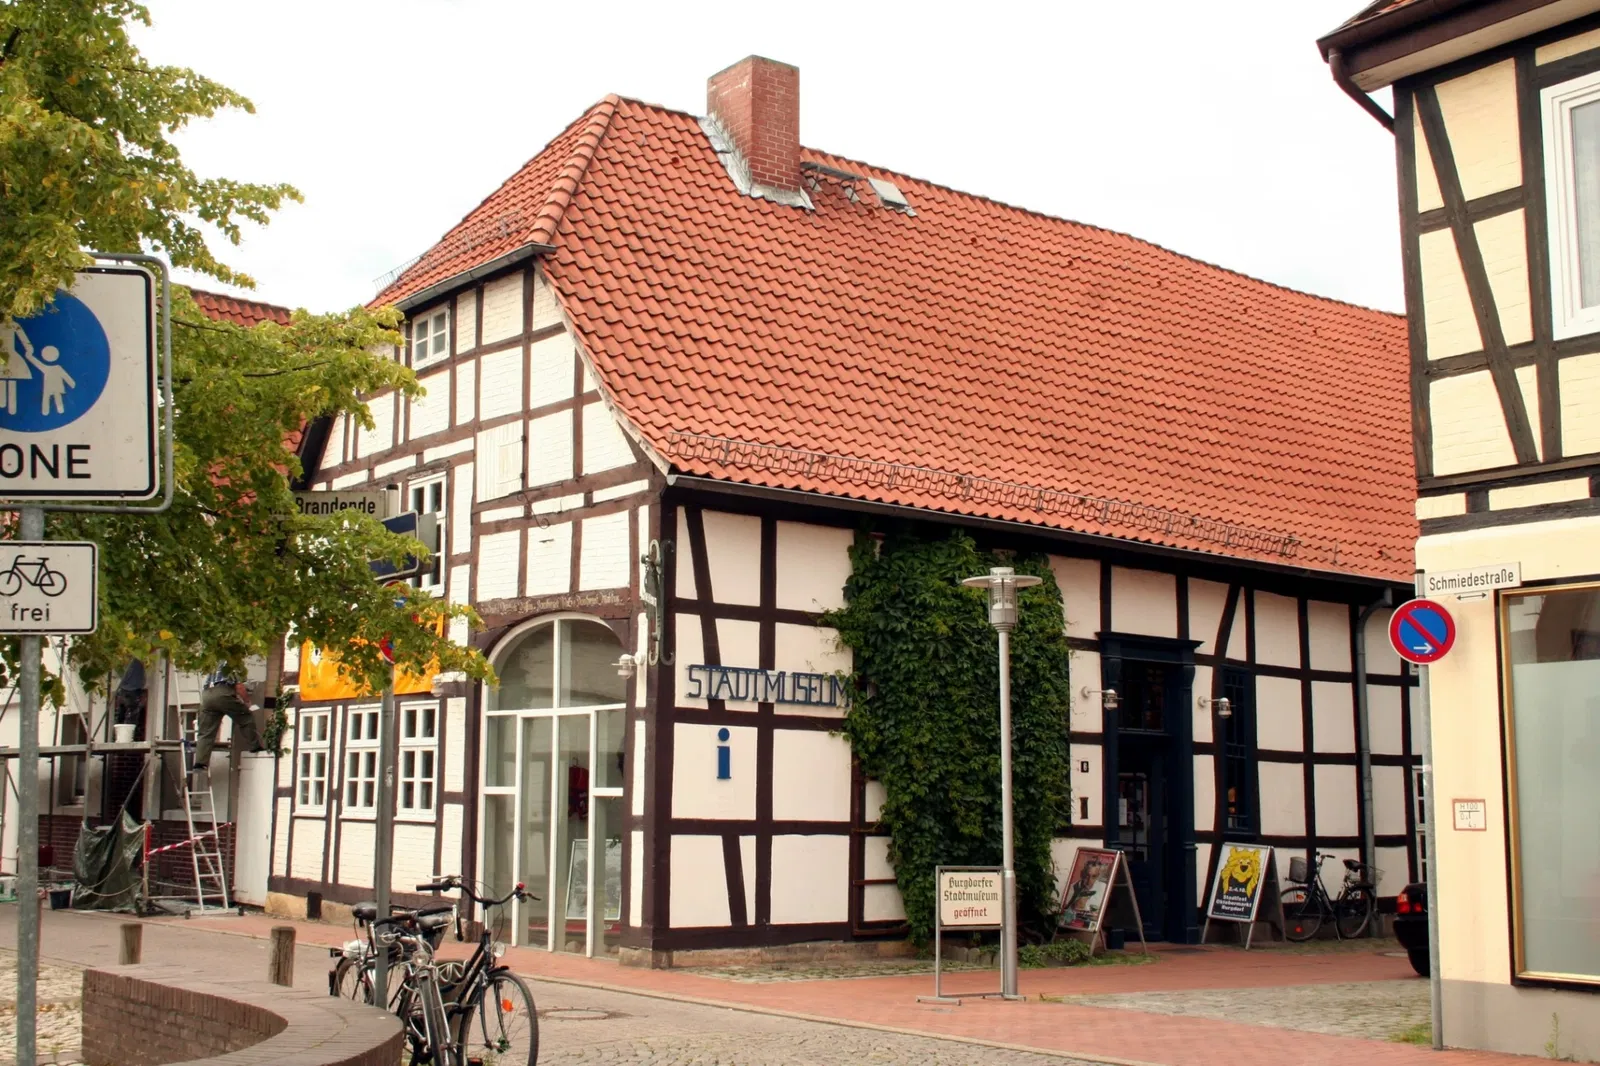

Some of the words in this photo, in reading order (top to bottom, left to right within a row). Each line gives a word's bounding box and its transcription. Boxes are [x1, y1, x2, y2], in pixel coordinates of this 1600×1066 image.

[0, 443, 92, 479] ONE
[1429, 568, 1514, 591] Schmiedestraße
[11, 602, 50, 621] frei
[685, 664, 851, 708] STADTMUSEUM
[948, 877, 993, 890] Burgdorfer
[954, 907, 987, 919] geöffnet
